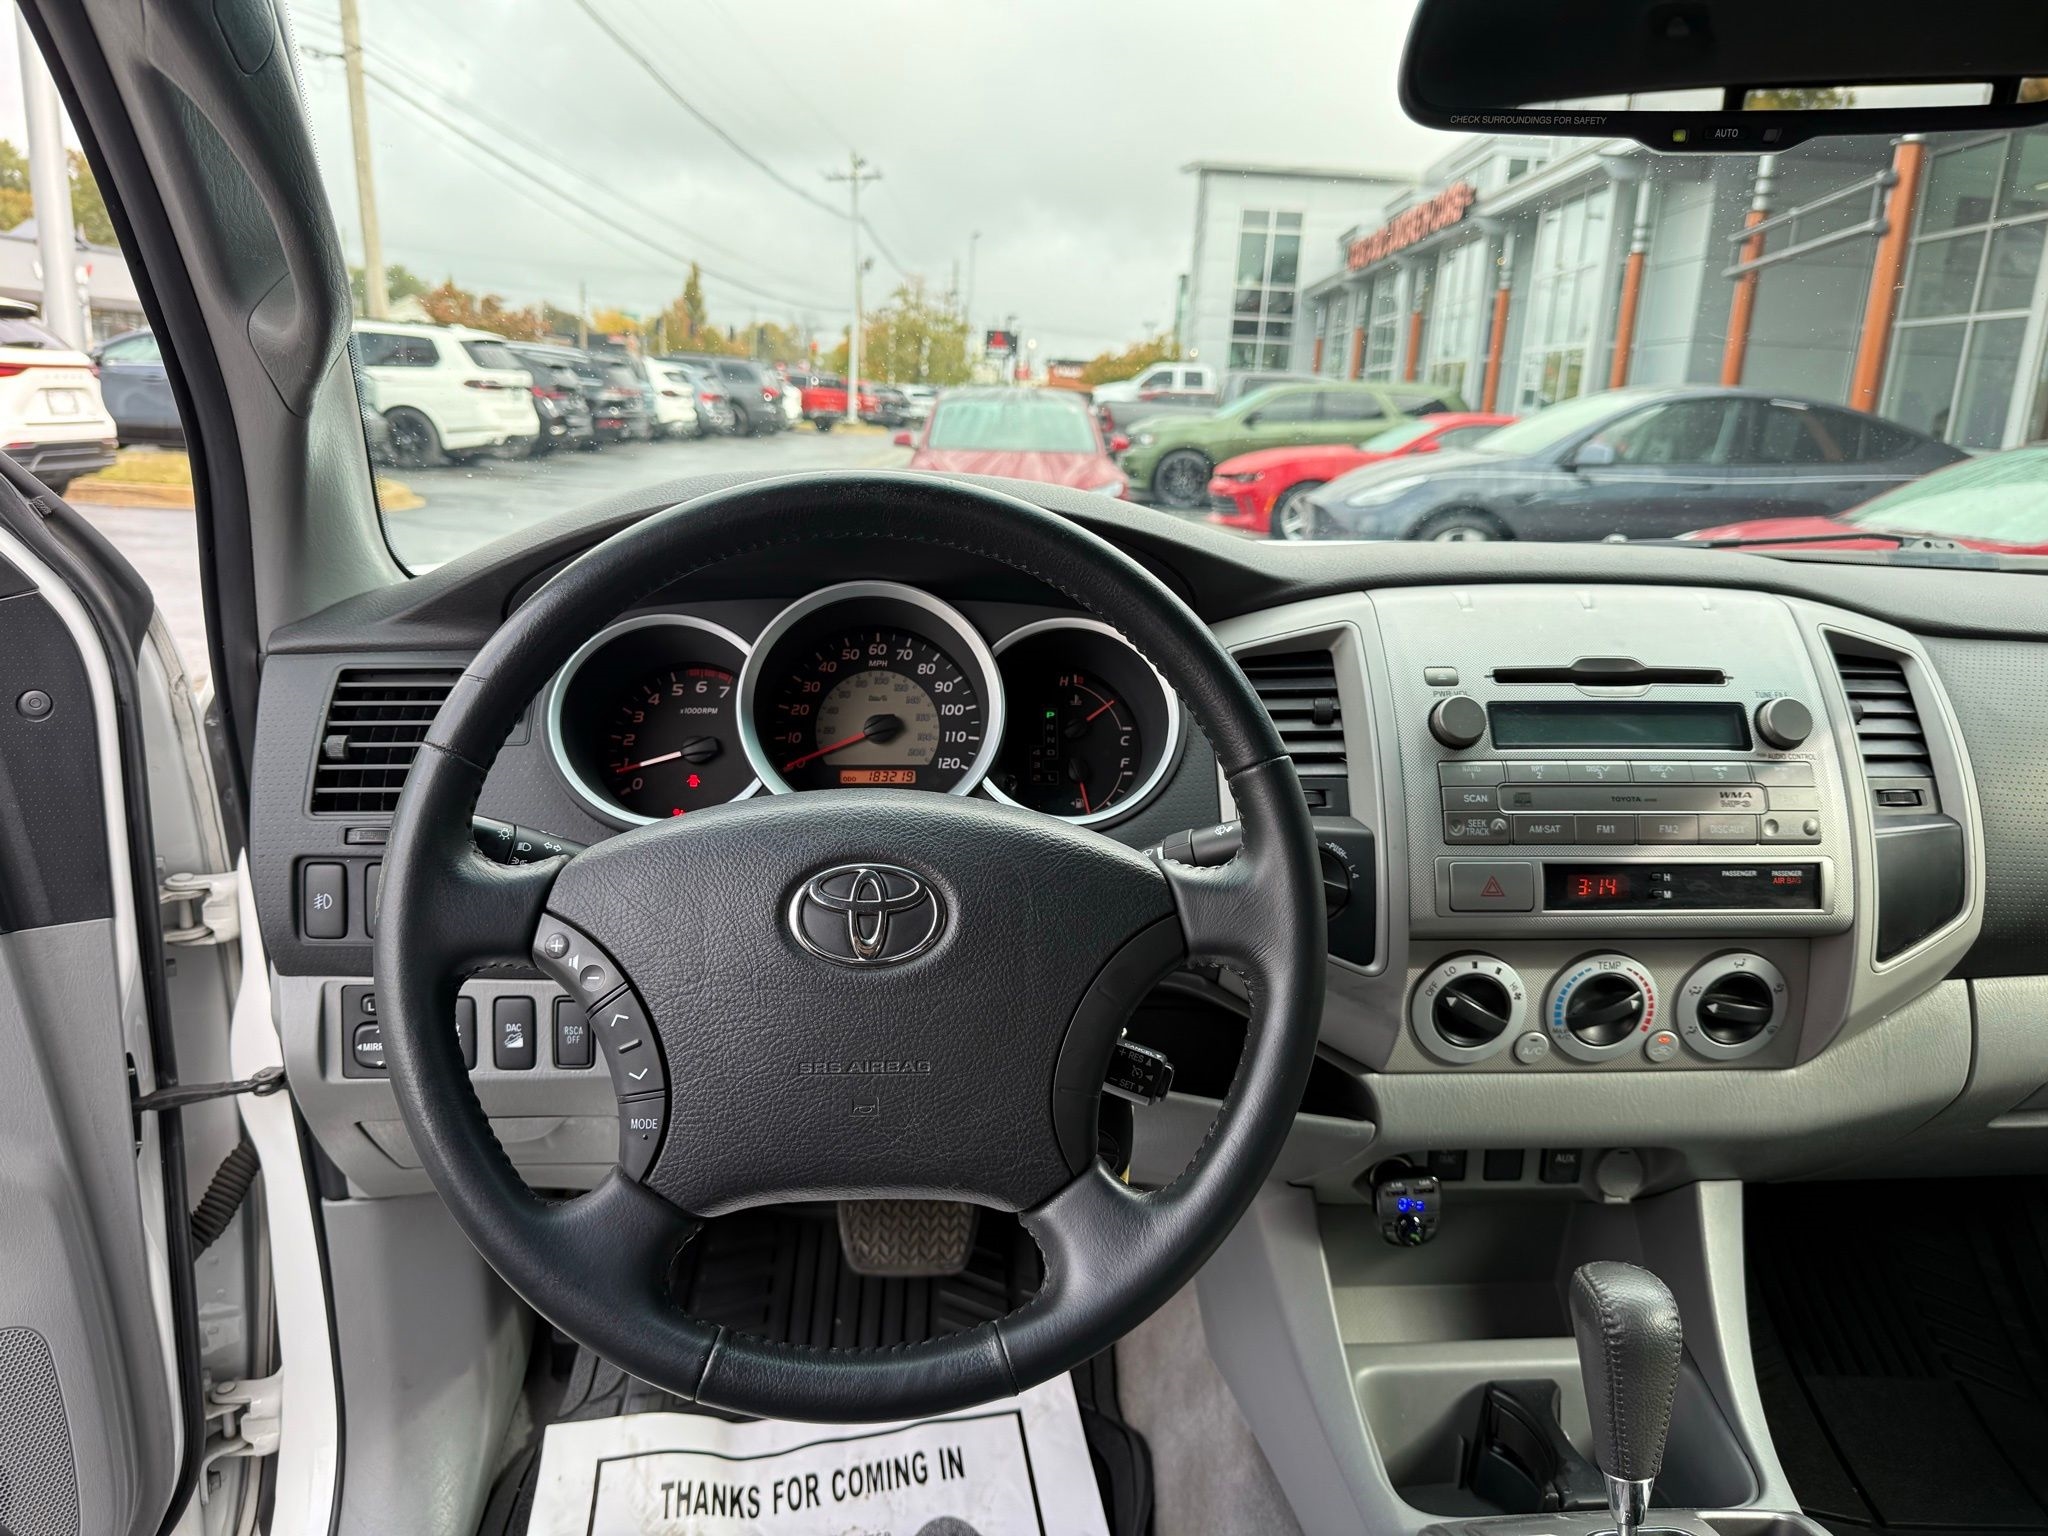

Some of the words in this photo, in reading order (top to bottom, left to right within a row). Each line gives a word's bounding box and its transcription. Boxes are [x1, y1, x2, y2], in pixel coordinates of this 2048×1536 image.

[1450, 115, 1480, 125] CHECK
[1482, 115, 1552, 125] SURROUNDINGS
[1553, 116, 1572, 125] FOR
[1573, 116, 1608, 125] SAFETY
[1714, 128, 1738, 138] AUTO
[841, 649, 860, 660] 50
[868, 644, 887, 655] 60
[896, 649, 913, 661] 70
[818, 661, 837, 672] 40
[917, 663, 936, 675] 80
[696, 681, 707, 693] 6
[1059, 676, 1069, 687] H
[672, 683, 684, 696] 5
[719, 686, 730, 698] 7
[802, 682, 821, 693] 30
[934, 682, 953, 693] 90
[648, 693, 660, 705] 4
[790, 704, 809, 715] 20
[940, 704, 964, 716] 100
[633, 711, 644, 723] 3
[623, 734, 635, 746] 2
[788, 732, 802, 743] 10
[945, 731, 967, 743] 110
[1120, 736, 1130, 746] C
[938, 757, 960, 769] 120
[1120, 758, 1130, 768] F
[868, 771, 914, 782] 183219
[632, 778, 643, 790] 0
[1464, 794, 1488, 803] SCAN
[1468, 819, 1486, 827] SEEK
[1466, 828, 1489, 836] TRACK
[1596, 825, 1615, 833] FM1
[1659, 825, 1679, 833] FM2
[1663, 873, 1671, 881] H
[1578, 878, 1617, 896] 3:14
[1663, 890, 1671, 899] M
[1598, 961, 1621, 970] TEMP
[1444, 966, 1457, 977] LO
[1425, 980, 1438, 997] OFF
[367, 1002, 375, 1012] L
[506, 1023, 522, 1032] DAC
[564, 1026, 583, 1035] RSCA
[567, 1035, 580, 1044] OFF
[1522, 1046, 1543, 1056] A/C
[1128, 1051, 1144, 1063] RES
[800, 1061, 842, 1073] SRS
[849, 1060, 931, 1073] AIRBAG
[1119, 1079, 1135, 1090] SET
[631, 1119, 658, 1130] MODE
[1556, 1154, 1576, 1162] AUX
[661, 1480, 760, 1519] THANKS
[774, 1473, 821, 1514] FOR
[832, 1451, 928, 1502] COMING
[938, 1447, 966, 1480] IN
